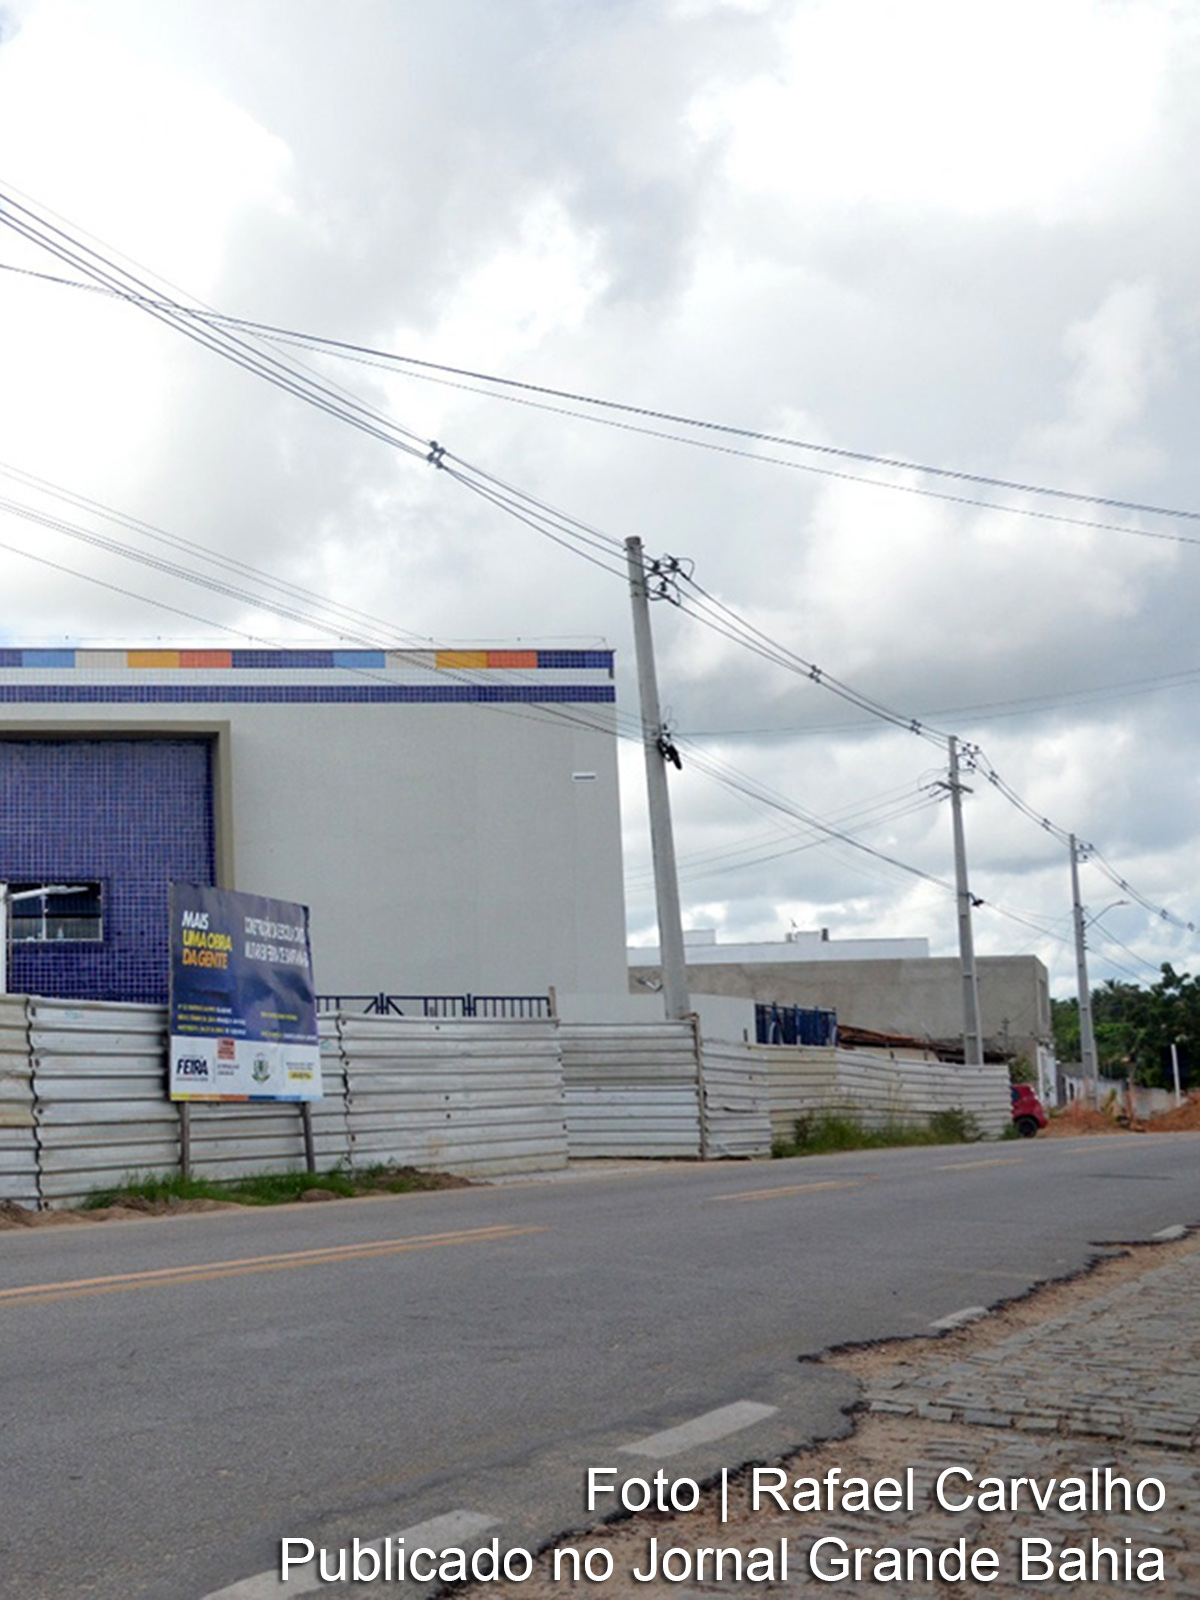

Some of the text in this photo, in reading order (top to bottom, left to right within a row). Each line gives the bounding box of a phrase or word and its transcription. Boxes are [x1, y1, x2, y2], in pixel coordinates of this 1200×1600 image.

[181, 910, 209, 930] MAIS
[183, 929, 232, 952] UMA OBRA
[182, 948, 197, 966] DA
[198, 950, 228, 969] GENTE
[176, 1058, 208, 1076] FEIRA
